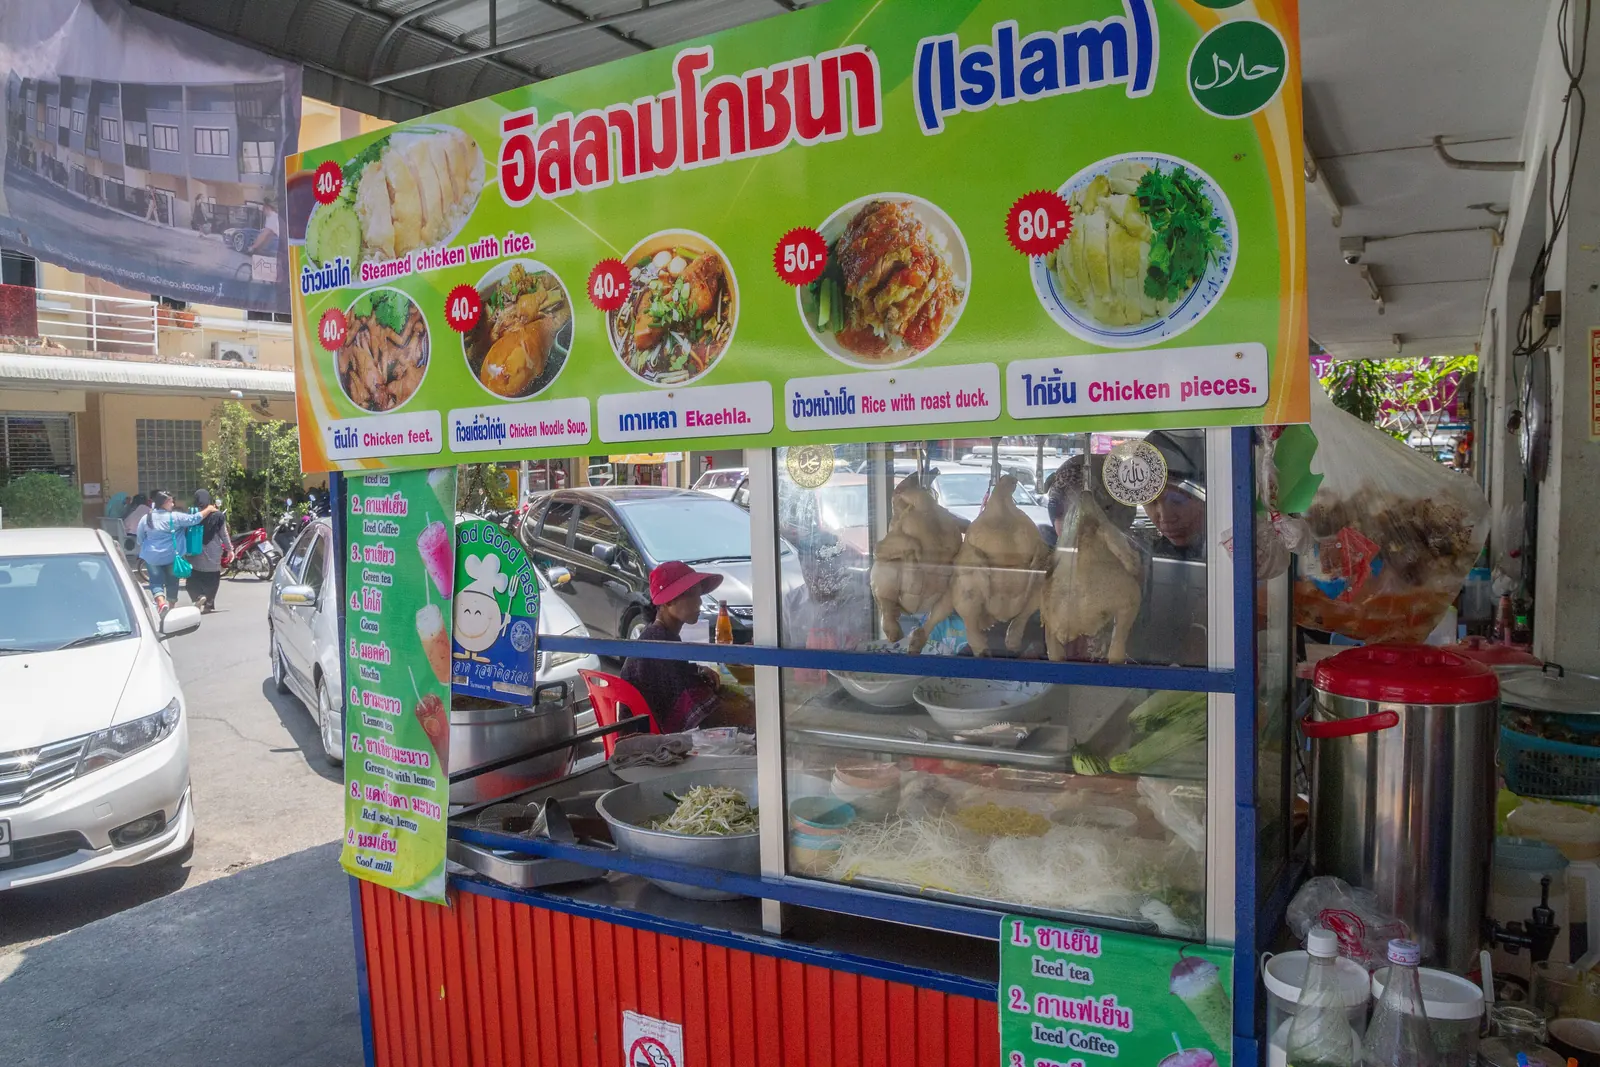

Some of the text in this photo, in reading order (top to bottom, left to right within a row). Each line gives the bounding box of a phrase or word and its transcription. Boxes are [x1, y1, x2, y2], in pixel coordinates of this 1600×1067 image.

[919, 0, 1152, 129] (Islam)
[1195, 52, 1279, 90] حلال
[502, 52, 876, 201] อิสลามโภชนา
[318, 172, 340, 194] 40.-
[1019, 208, 1065, 241] 80.-
[362, 234, 535, 281] Steamed chicken with rice.
[784, 243, 823, 272] 50.-
[302, 258, 349, 294] ข้าวมันไก่
[594, 273, 624, 299] 40.-
[452, 297, 478, 321] 40.-
[324, 320, 345, 341] 40.-
[1022, 368, 1076, 406] ไก่ชิ้น
[1088, 376, 1257, 402] Chicken pieces.
[793, 387, 855, 418] ข้าวหน้าเป็ด
[862, 388, 989, 414] Rice with roast duck.
[509, 418, 588, 439] Chicken Noodle Soup.
[619, 410, 677, 431] เกาเหลา
[686, 408, 751, 427] Ekaehla.
[364, 429, 433, 447] Chicken feet.
[353, 494, 406, 514] 2. กาแฟเย็น
[364, 522, 398, 535] Iced Coffee
[352, 545, 394, 563] 3. ชาเขียว
[363, 570, 391, 584] Green tea
[456, 523, 537, 614] ood Good Taste
[351, 592, 359, 608] 4.
[361, 619, 378, 632] Cocoa
[360, 666, 379, 680] Mocha
[453, 661, 471, 675] อาด
[351, 688, 400, 713] 6. ชามะนาว
[363, 714, 383, 729] Lemon
[352, 736, 361, 751] 7.
[365, 761, 385, 774] Green
[395, 771, 410, 783] with
[414, 773, 435, 788] lemon
[351, 782, 360, 798] 8.
[411, 798, 440, 819] มะนาว
[362, 809, 417, 831] Red soda lemon
[348, 829, 396, 852] 9. นมเย็น
[375, 858, 392, 872] milk
[1011, 922, 1098, 954] 1. ชาเย็น
[1034, 959, 1090, 982] Iced tea
[1010, 989, 1129, 1029] 2. กาแฟเย็น
[1034, 1026, 1116, 1054] Iced Coffee
